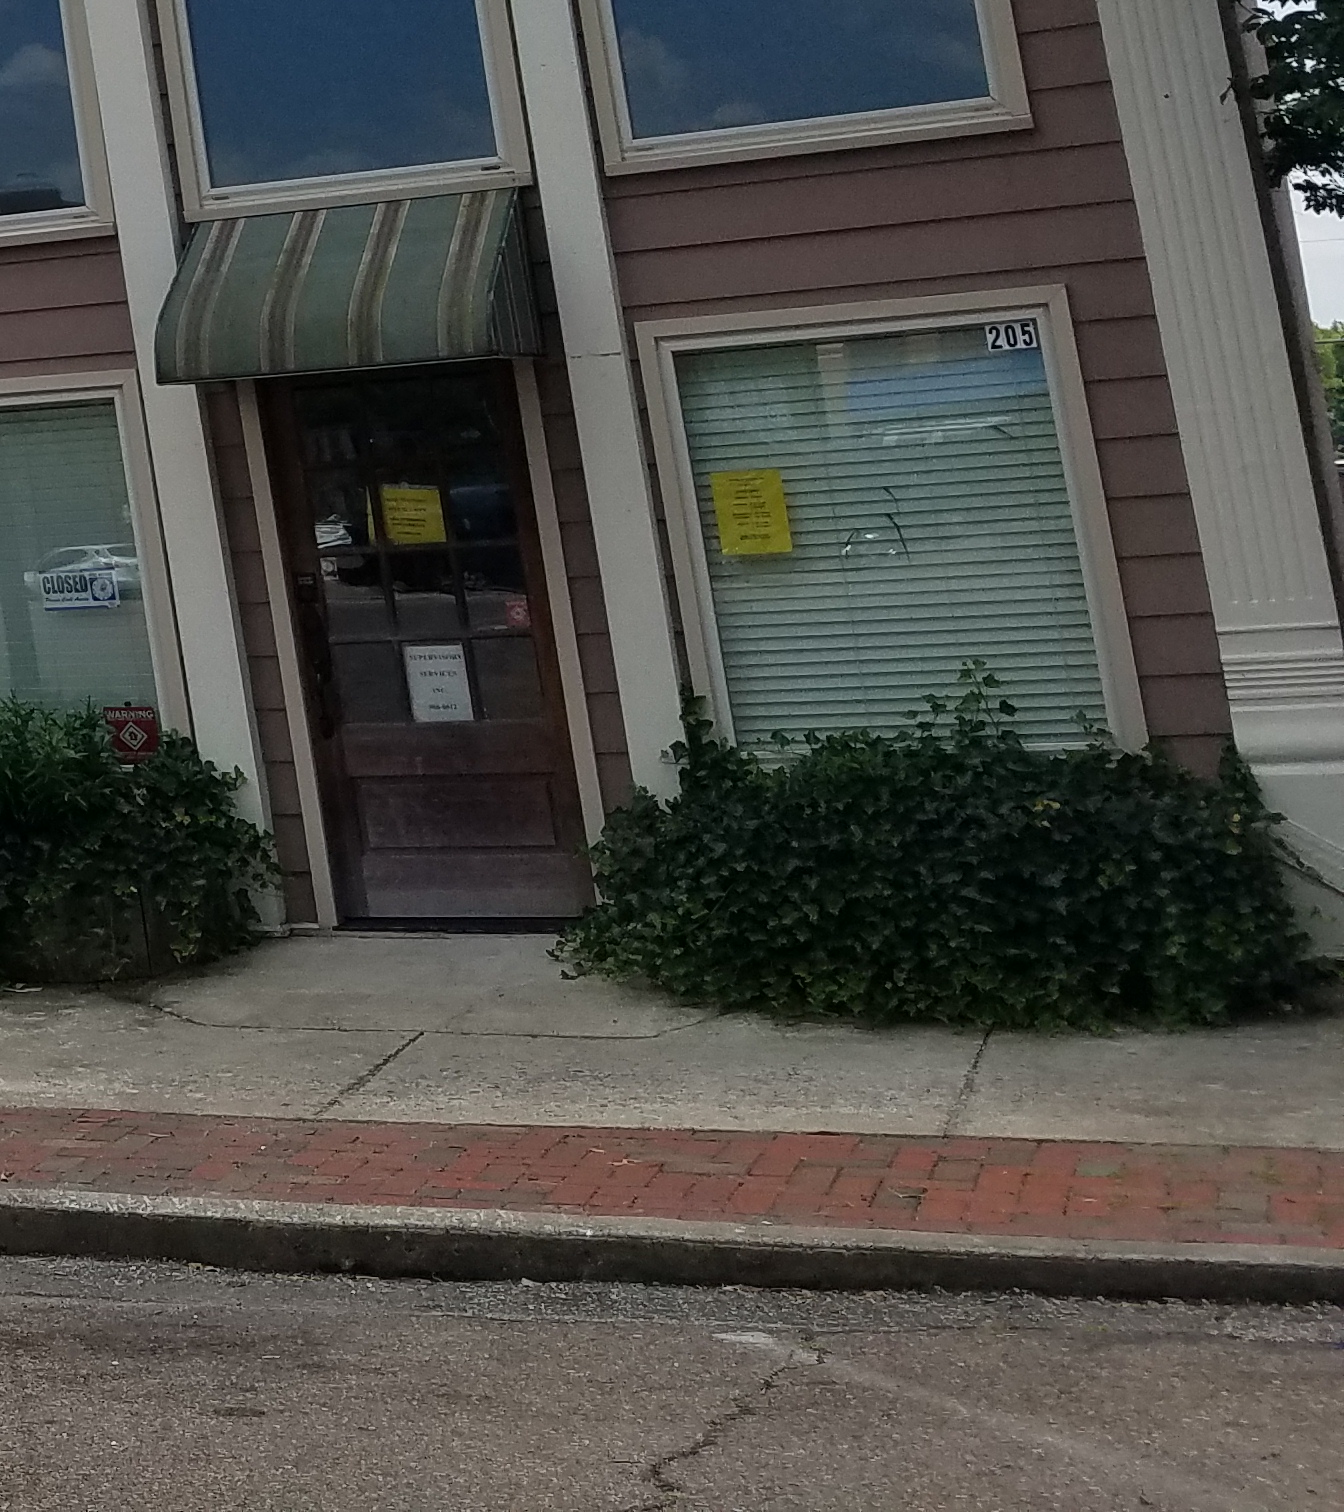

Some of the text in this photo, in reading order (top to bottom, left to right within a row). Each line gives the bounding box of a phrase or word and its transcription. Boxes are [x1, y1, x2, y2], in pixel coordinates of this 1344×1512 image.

[988, 323, 1034, 349] 205
[42, 574, 89, 595] CLOSED
[104, 710, 154, 719] WARNING
